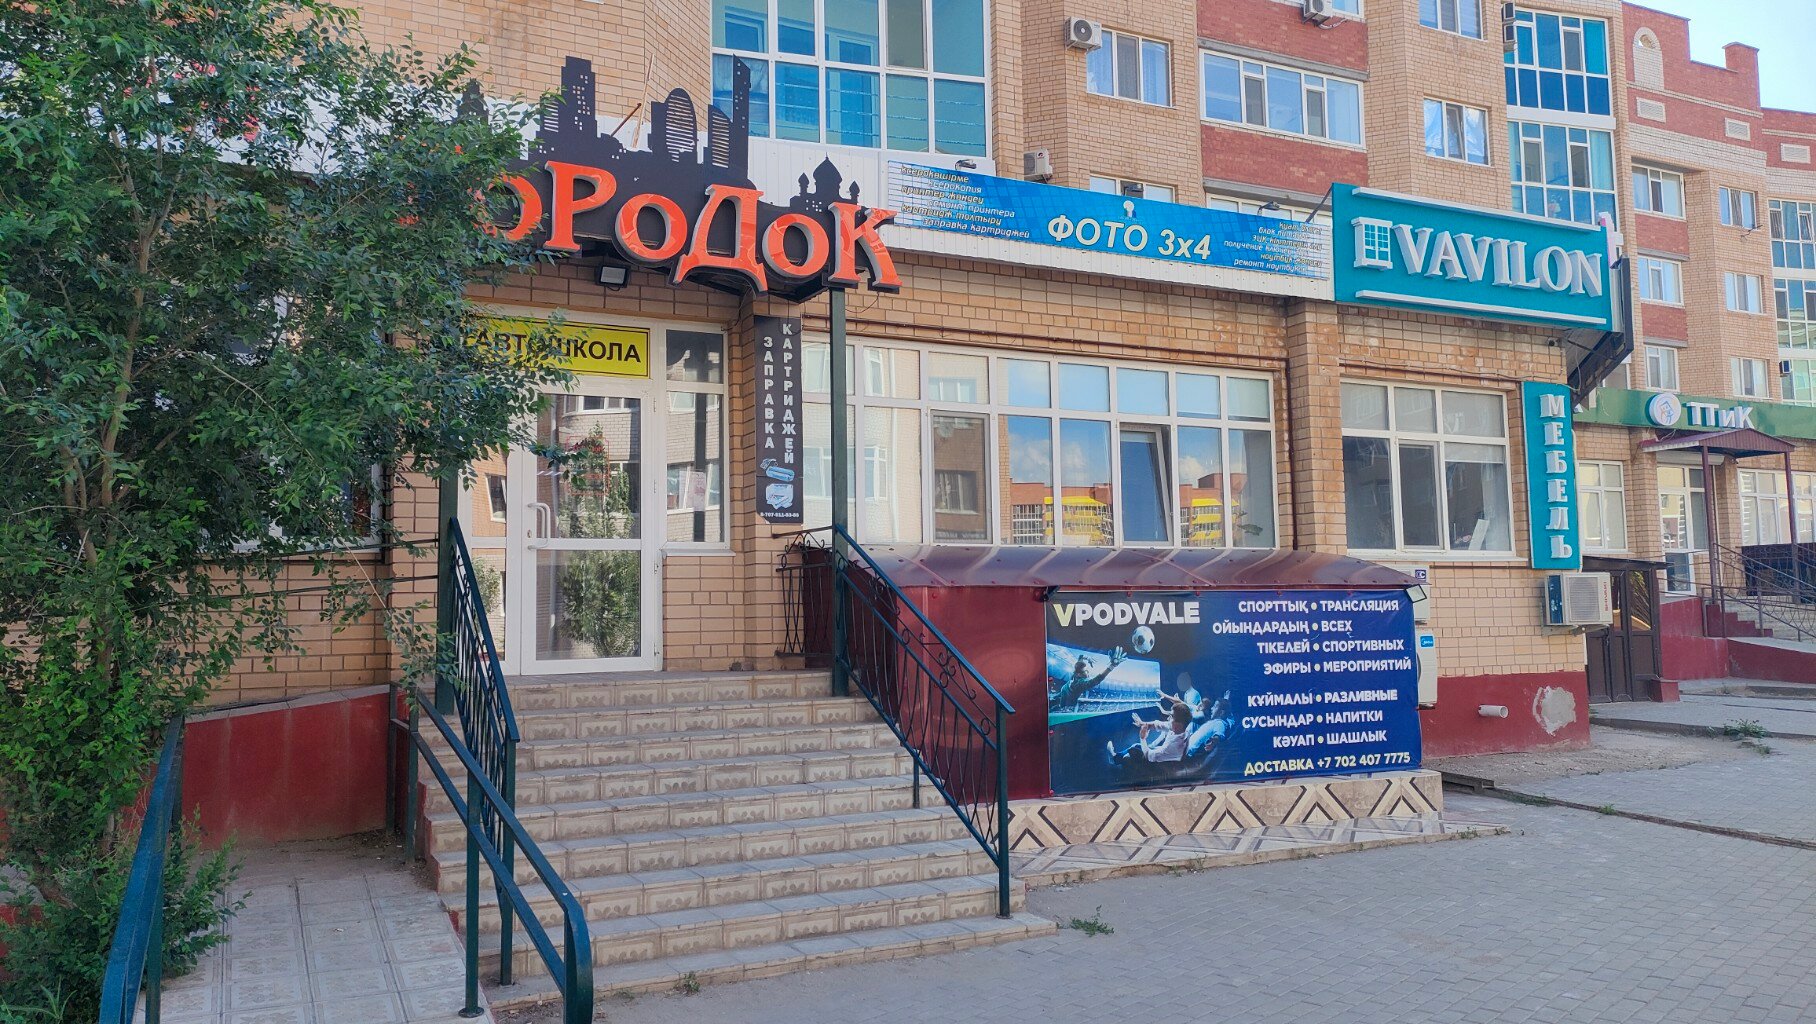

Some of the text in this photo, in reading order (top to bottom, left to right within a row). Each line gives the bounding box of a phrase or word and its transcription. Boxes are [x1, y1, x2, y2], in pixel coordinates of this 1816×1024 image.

[968, 205, 1015, 218] принтера
[922, 217, 1030, 239] заправка картриджей
[1047, 214, 1148, 252] ФОТО
[1233, 258, 1265, 269] ремонт
[1392, 223, 1603, 298] VAVILON
[763, 336, 775, 449] ЗАПРАВКА
[781, 323, 797, 464] КАРТРИДЖЕЙ
[1539, 393, 1573, 559] МЕБЕЛЬ
[1052, 601, 1201, 627] VPODVALE
[1238, 599, 1400, 614] СПОРТТЫҚ ТРАНСЛЯЦИЯ
[1212, 619, 1353, 635] ОЙЫНДАРДЫҢ ВСЕХ
[1257, 638, 1311, 654] ТІКЕЛЕЙ
[1322, 639, 1405, 653] СПОРТИВНЫХ
[1263, 656, 1412, 675] ЭФИРЫ МЕРОПРИЯТИЙ
[1324, 689, 1398, 704] РАЗЛИВНЫЕ
[1242, 710, 1384, 729] СУСЫНДАР НАПИТКИ
[1273, 730, 1388, 749] КӘУАП ШАШЛЫК
[1243, 751, 1411, 776] ДОСТАВКА +7 702 407 7775
